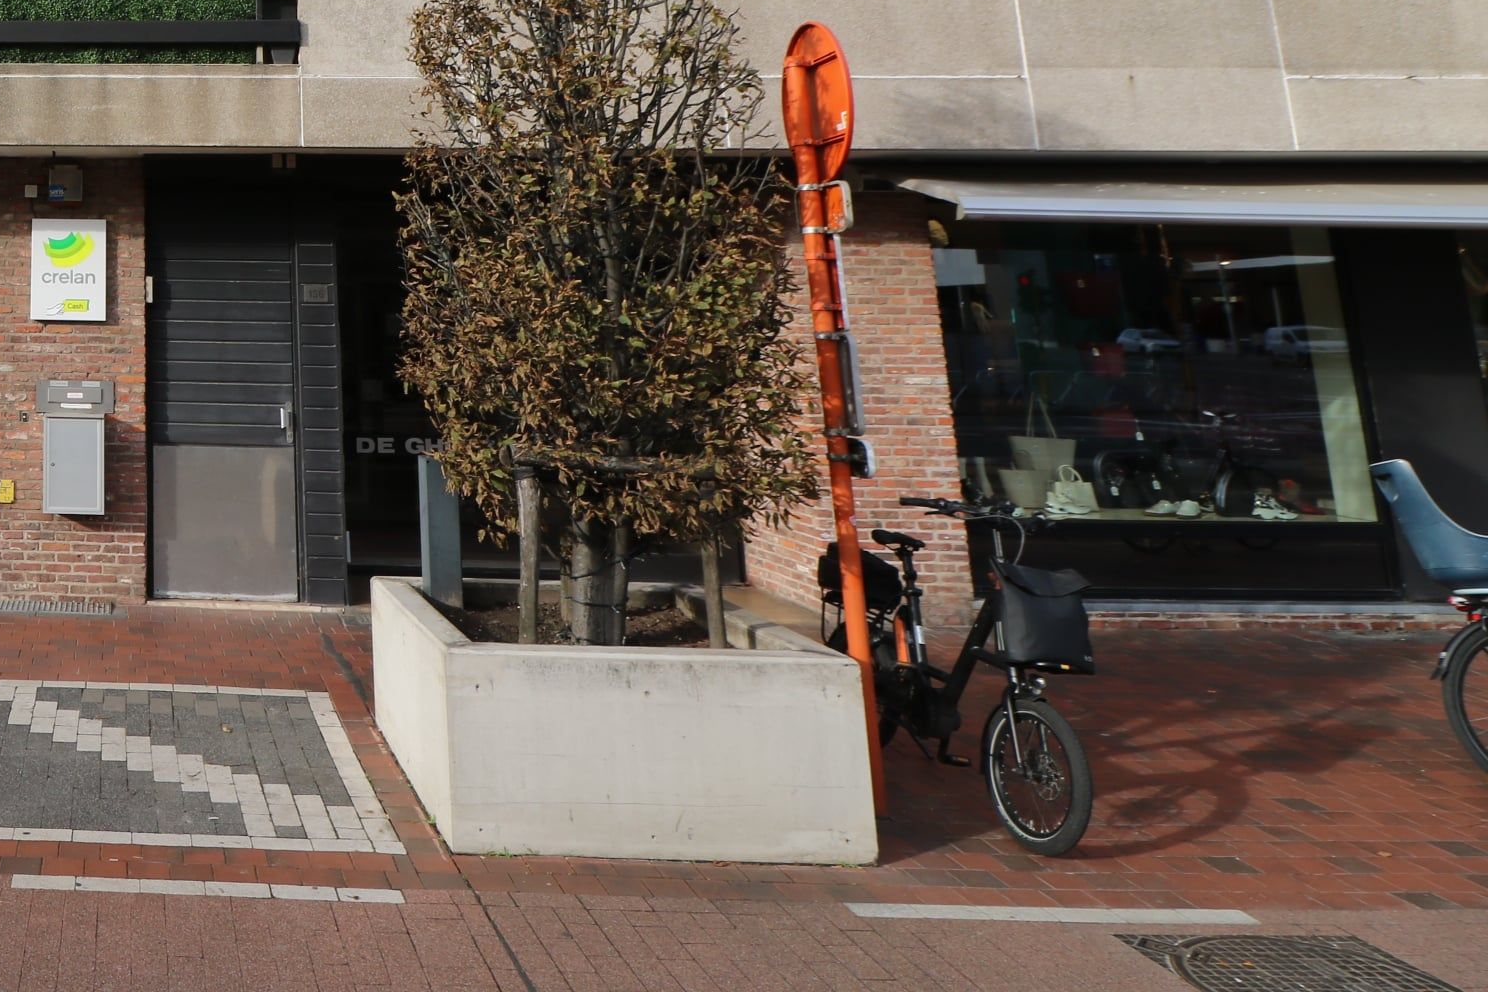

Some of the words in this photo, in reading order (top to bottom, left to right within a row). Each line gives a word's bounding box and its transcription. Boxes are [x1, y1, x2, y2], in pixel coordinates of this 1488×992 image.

[41, 269, 96, 285] crelan
[67, 302, 84, 310] Cash
[355, 437, 396, 454] DE
